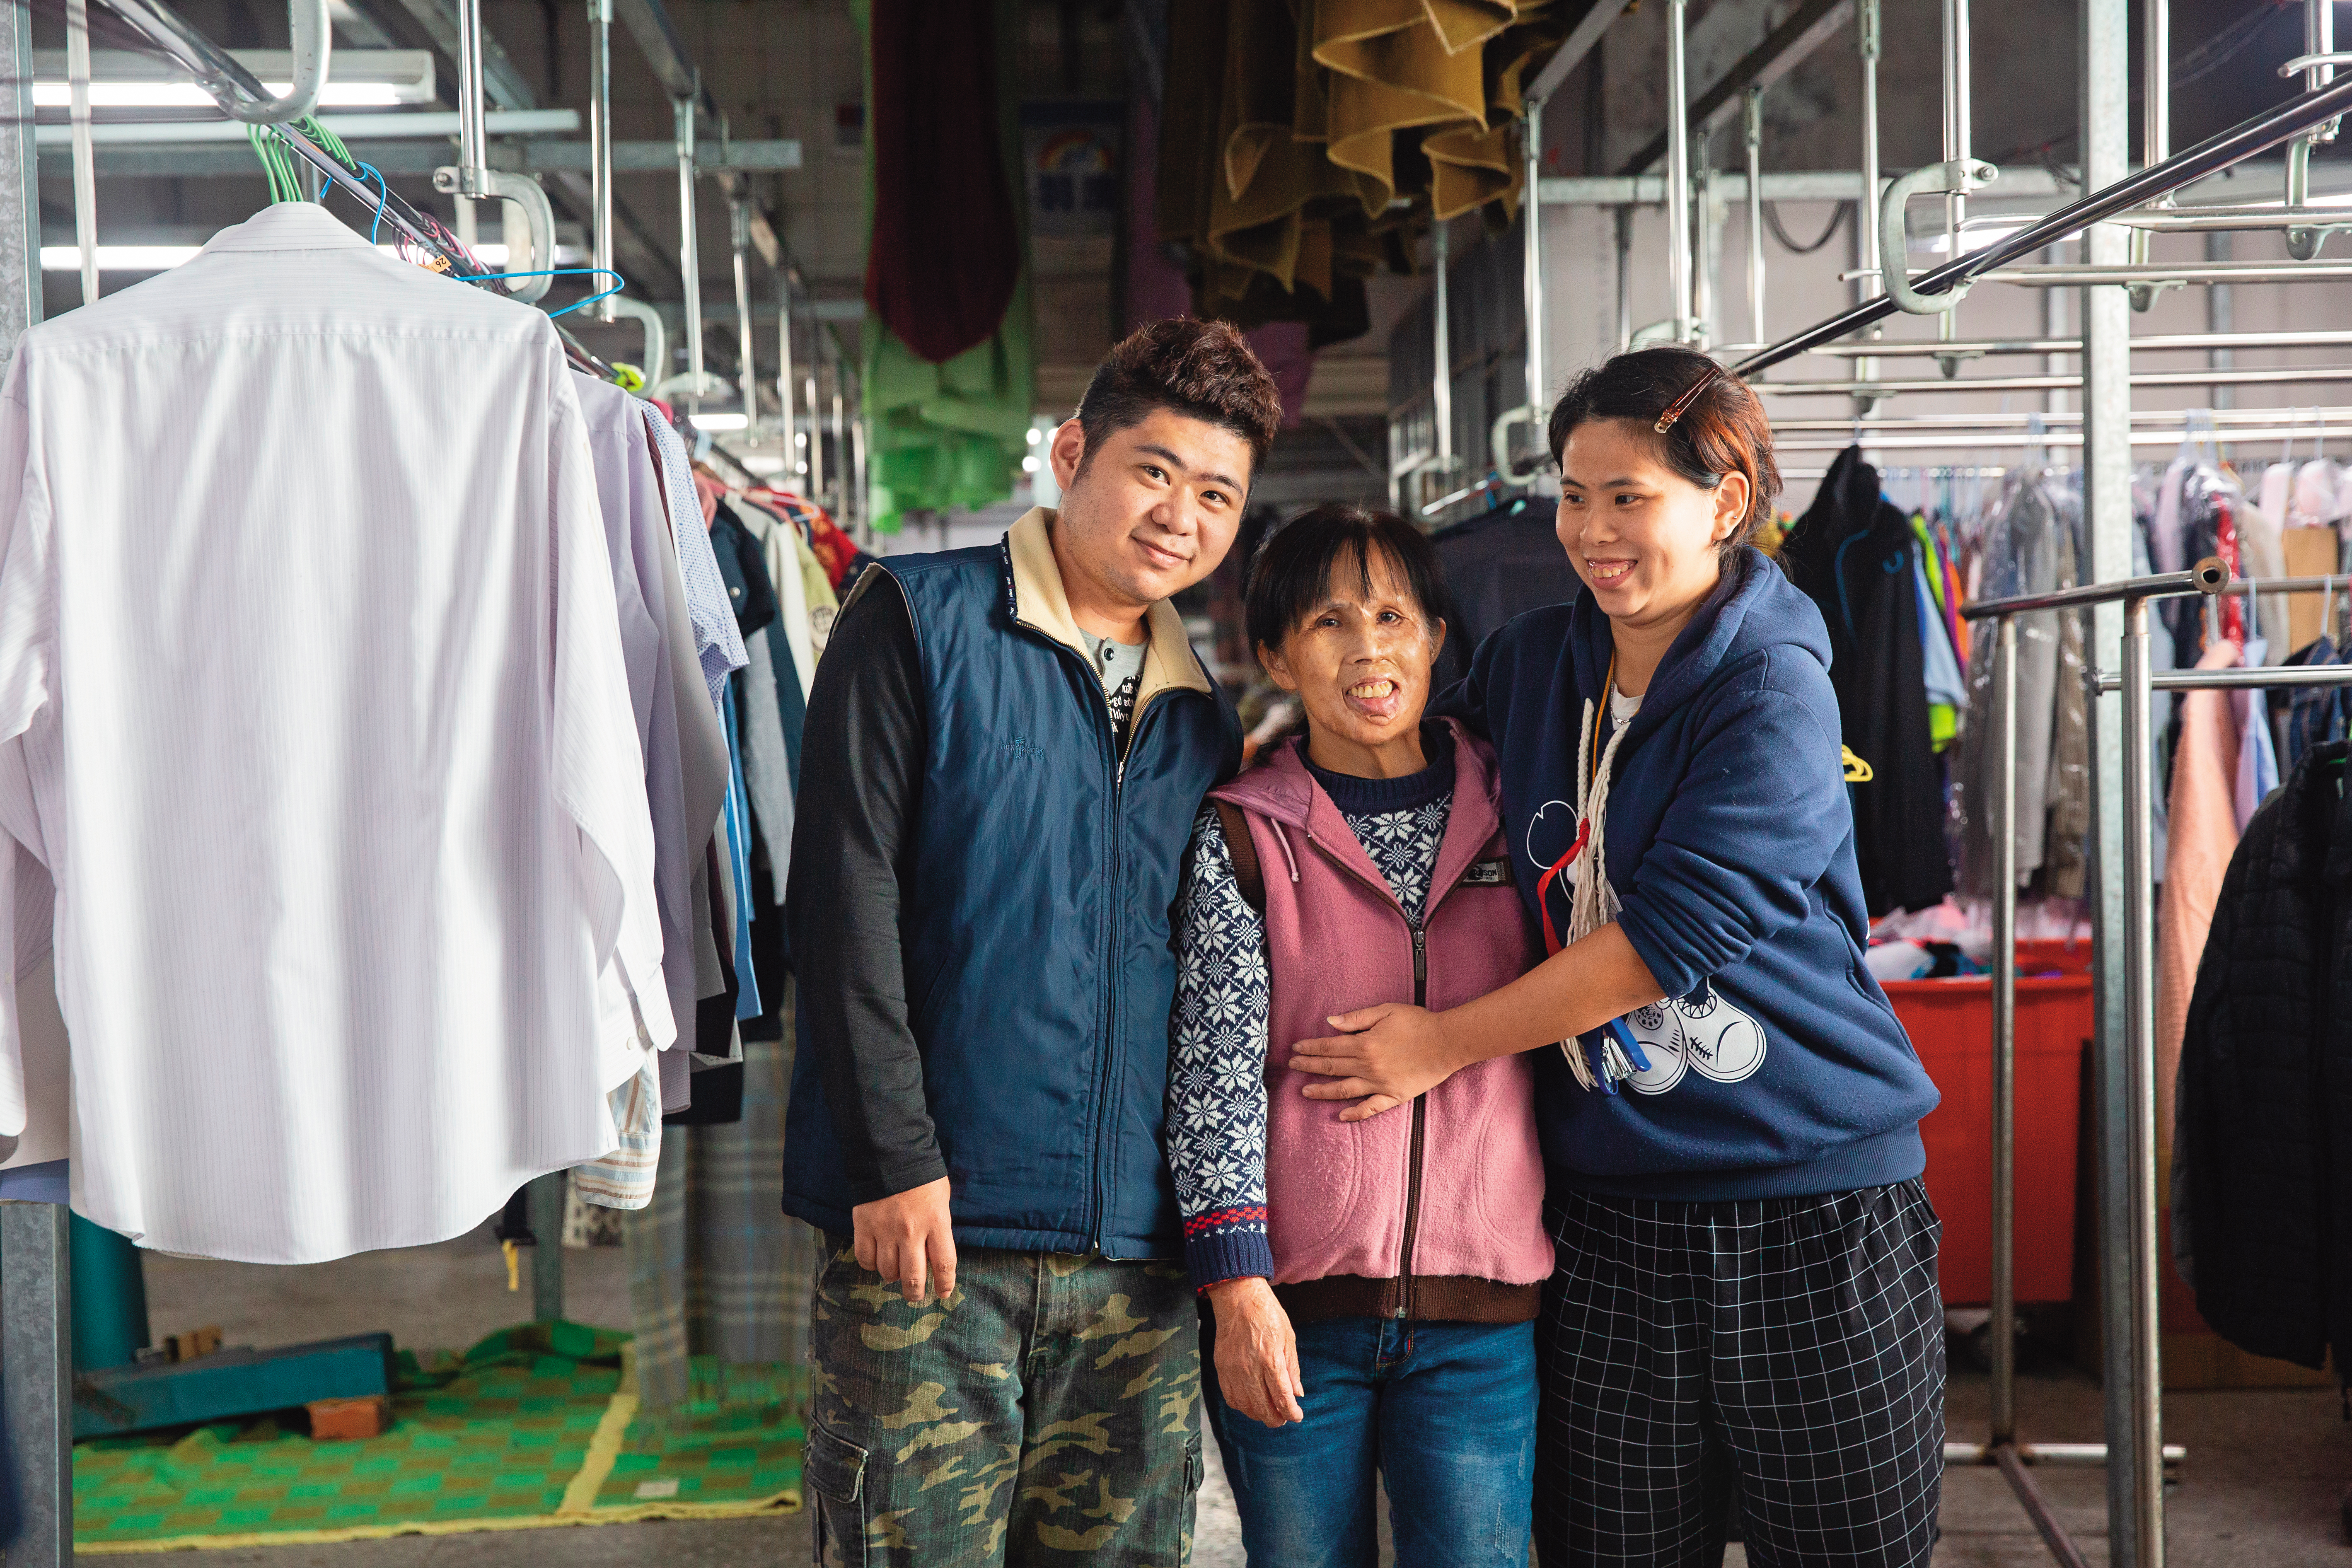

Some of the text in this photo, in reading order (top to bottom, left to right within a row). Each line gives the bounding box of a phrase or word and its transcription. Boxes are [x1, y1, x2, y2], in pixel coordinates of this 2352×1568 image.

[435, 257, 446, 267] 26
[996, 742, 1044, 757] JOHN SHEN
